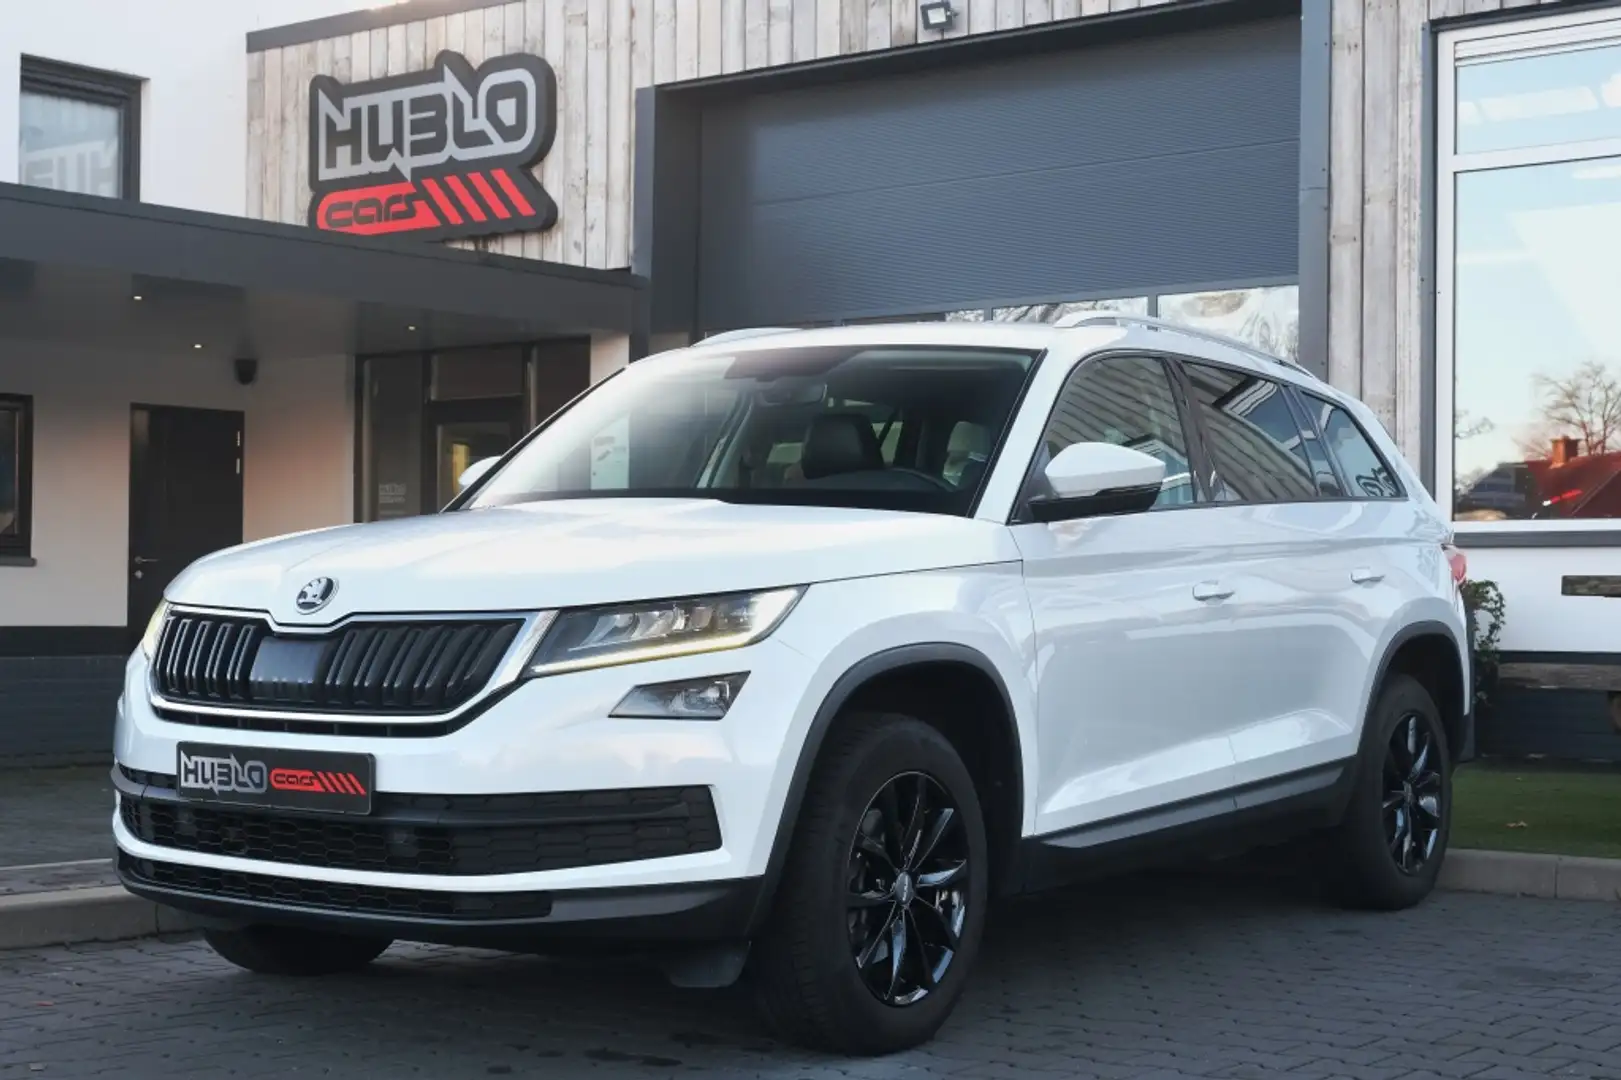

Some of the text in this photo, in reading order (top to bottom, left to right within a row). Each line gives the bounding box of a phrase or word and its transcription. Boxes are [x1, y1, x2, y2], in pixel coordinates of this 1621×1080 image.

[319, 66, 536, 180] HUBLO
[323, 190, 425, 229] cars
[181, 751, 318, 795] HUBLO cars
